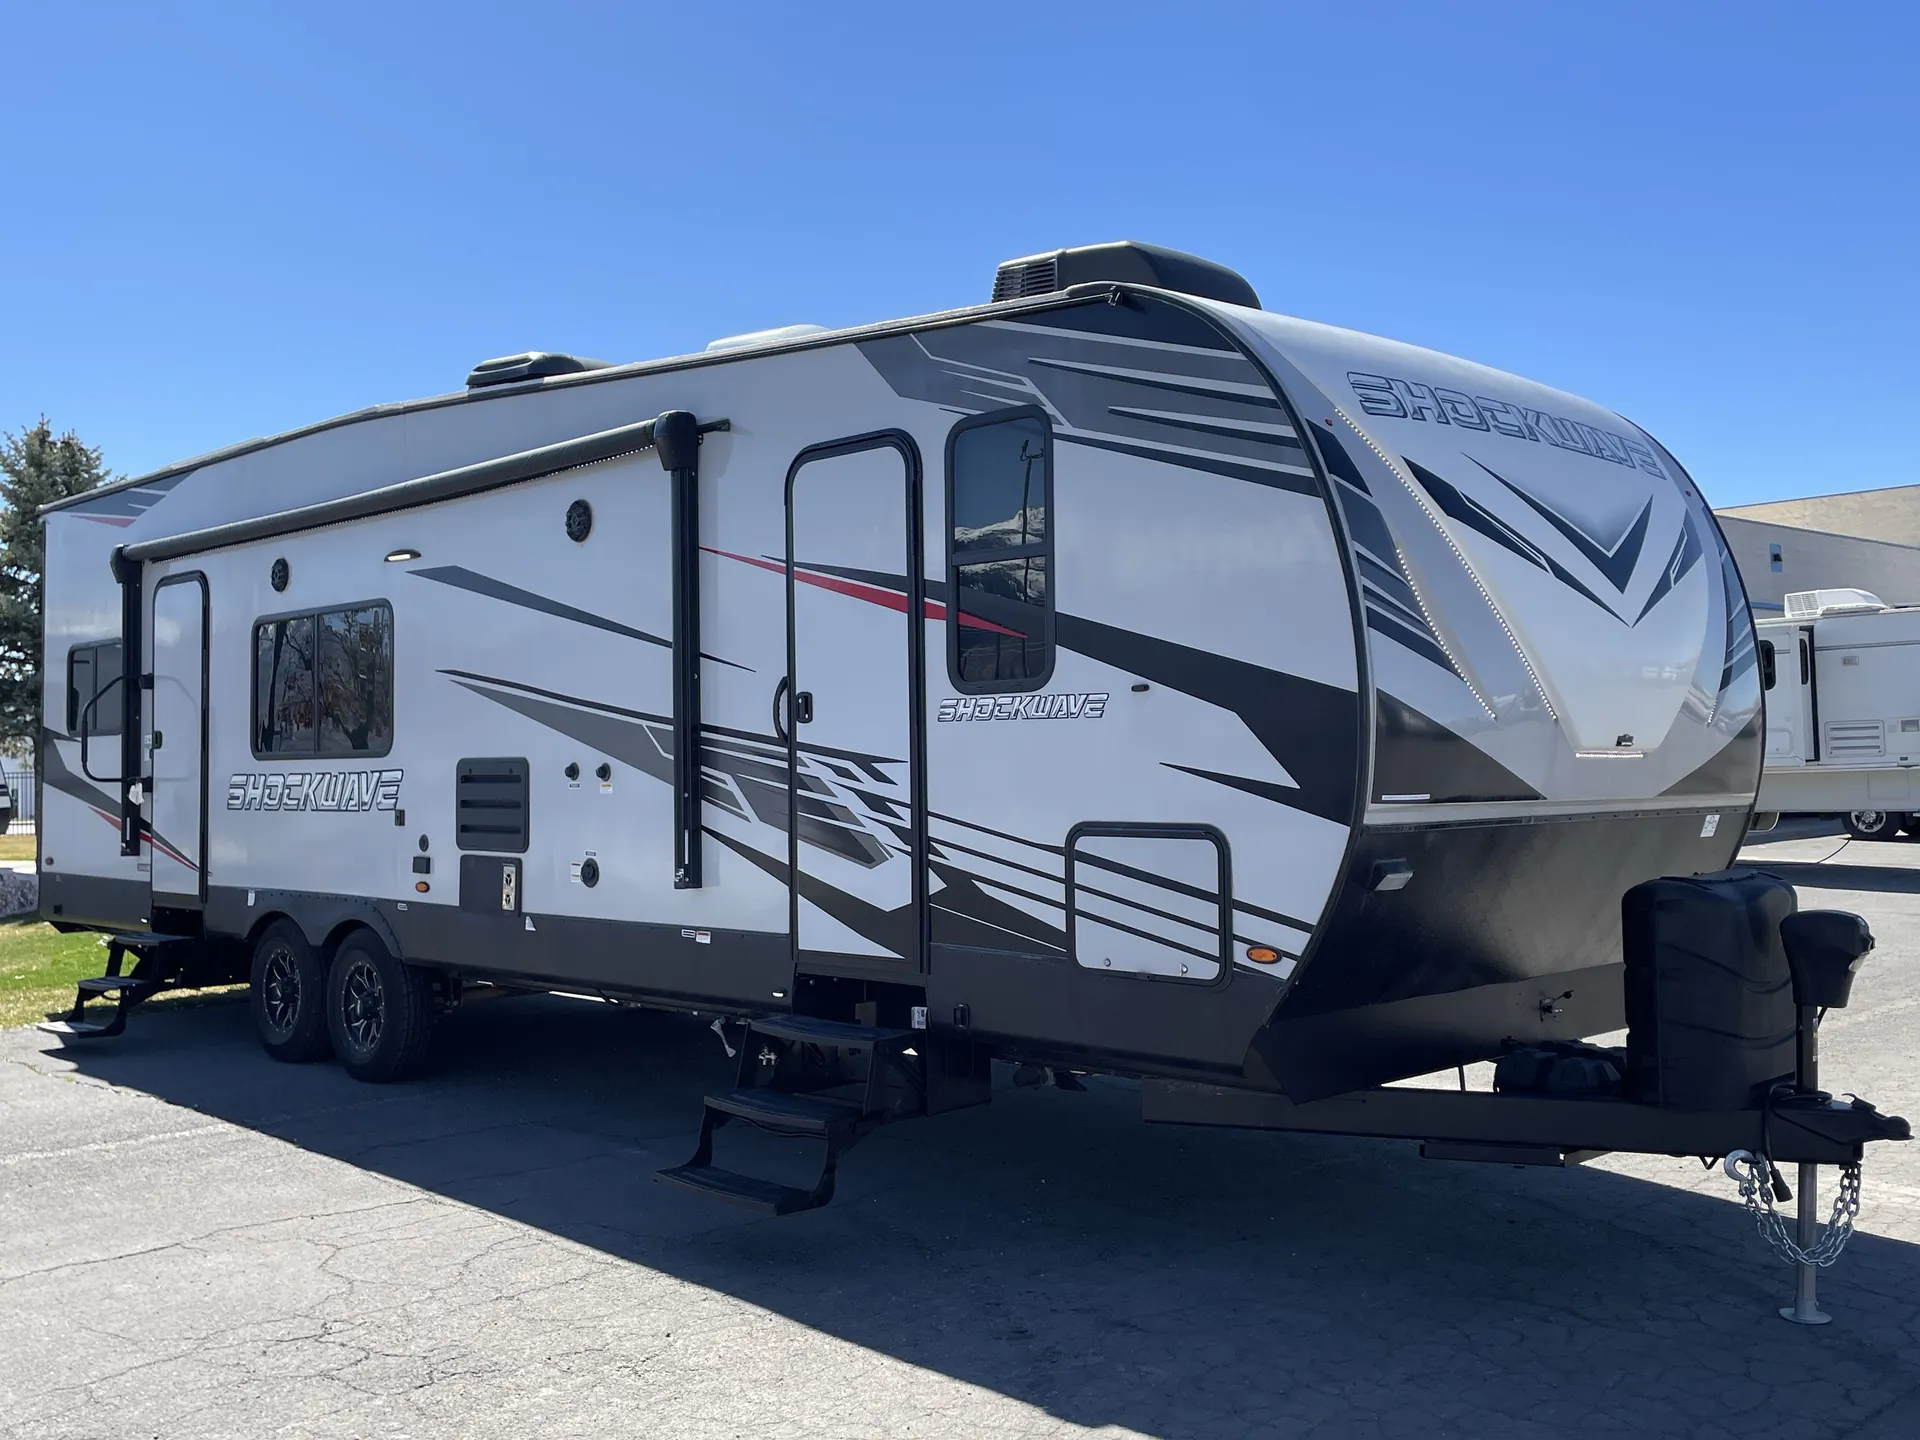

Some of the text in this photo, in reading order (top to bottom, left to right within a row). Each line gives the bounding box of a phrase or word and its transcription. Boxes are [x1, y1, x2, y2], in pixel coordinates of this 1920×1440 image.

[1347, 371, 1667, 480] SHOCKWAVE
[938, 692, 1109, 722] SHOCKWAVE
[227, 768, 404, 812] SHOCKWAVE
